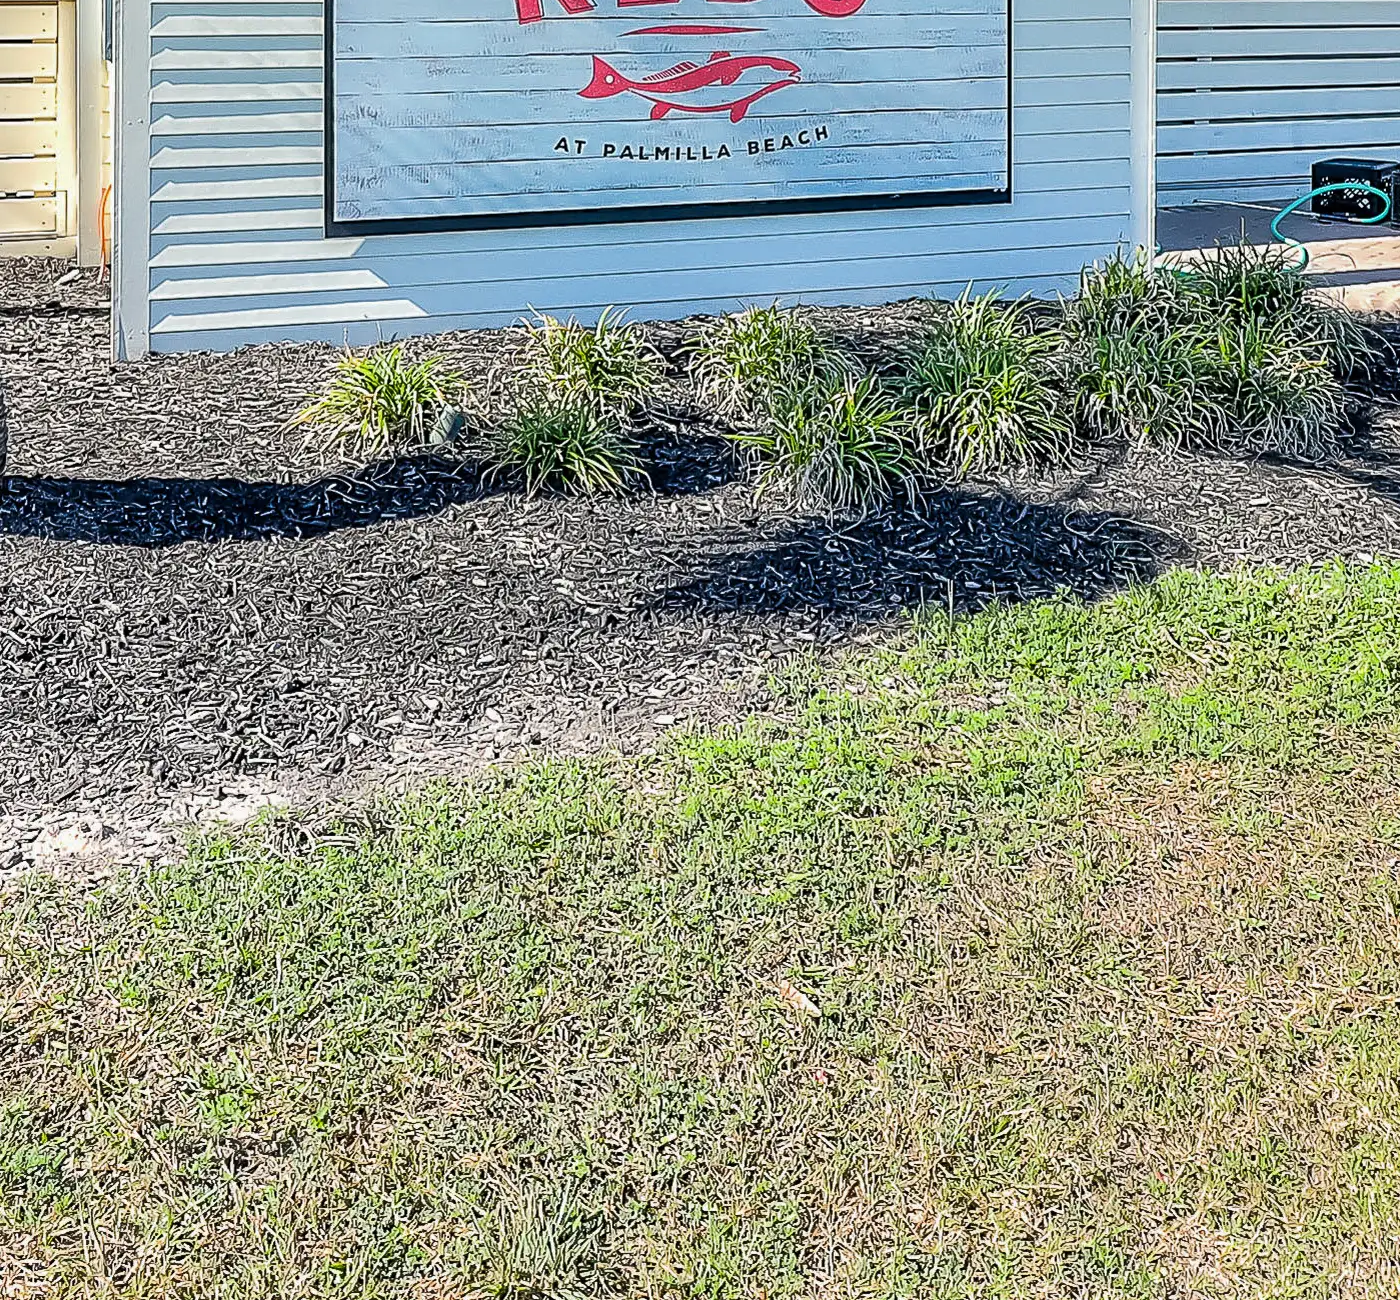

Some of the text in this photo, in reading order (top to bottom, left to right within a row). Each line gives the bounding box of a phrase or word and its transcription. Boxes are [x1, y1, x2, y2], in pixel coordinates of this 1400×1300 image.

[554, 125, 829, 161] AT PALMILLA BEACH
